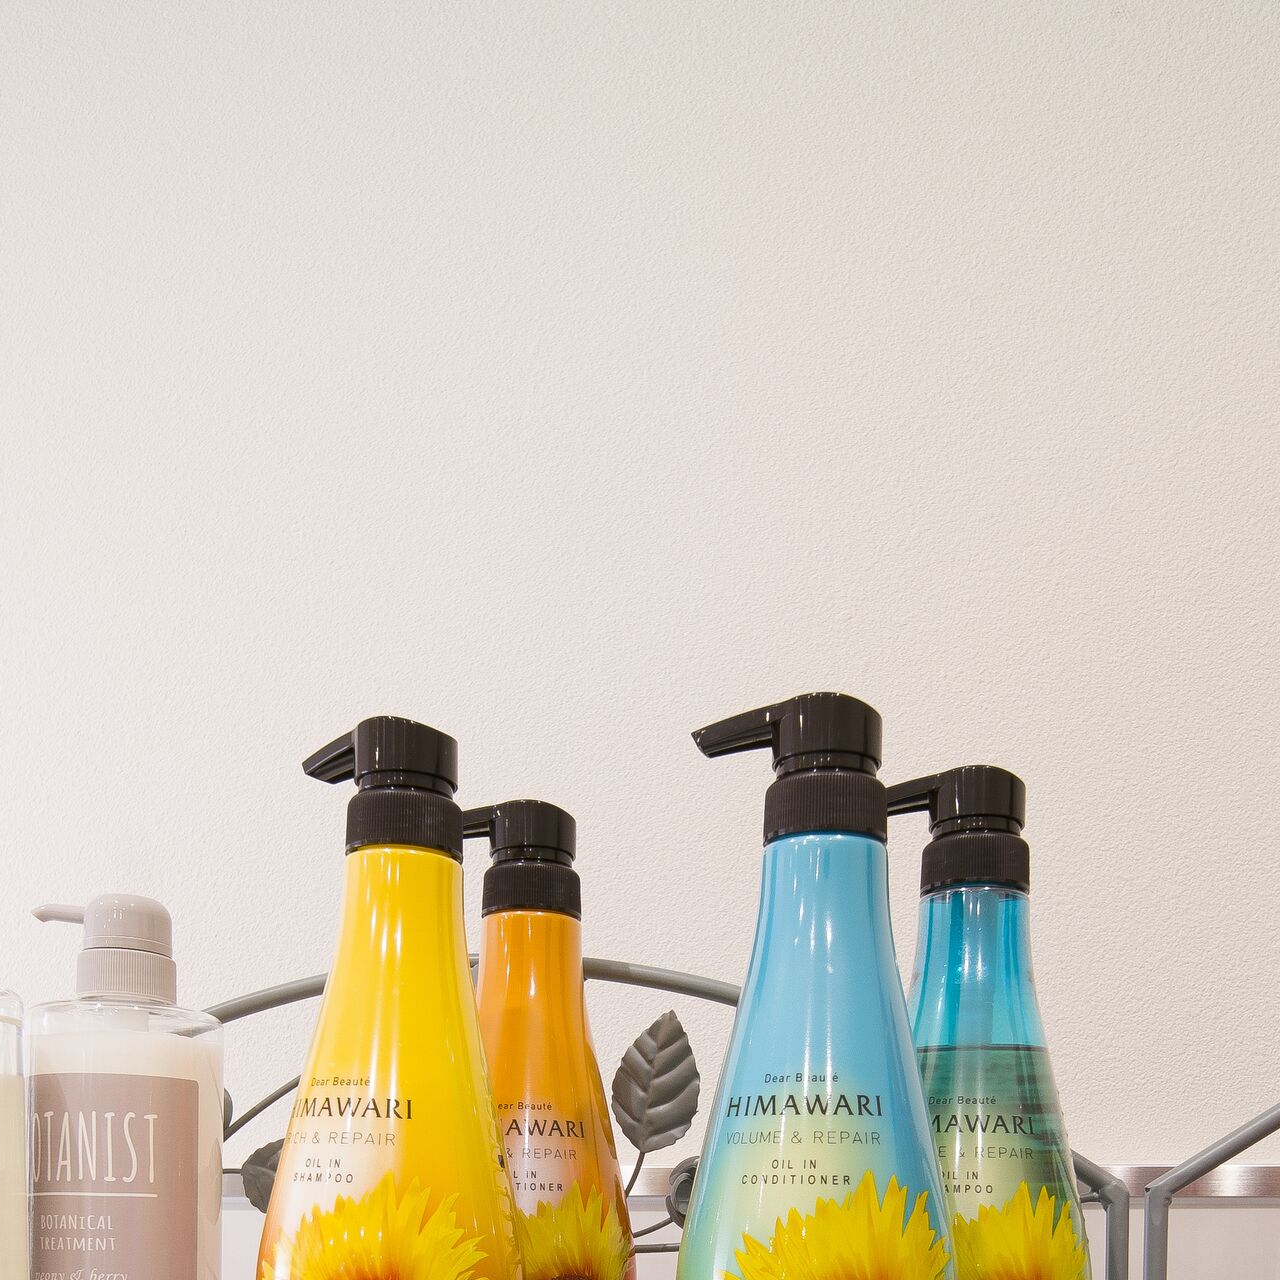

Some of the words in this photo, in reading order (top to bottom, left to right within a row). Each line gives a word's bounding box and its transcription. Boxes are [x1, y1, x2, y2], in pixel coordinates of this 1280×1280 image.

[311, 1077, 330, 1087] Dear
[332, 1075, 371, 1087] Beauté
[764, 1073, 791, 1084] Dear
[795, 1072, 839, 1083] Baué
[517, 1101, 552, 1111] Beauté
[727, 1094, 882, 1117] HIMAWARI
[928, 1096, 953, 1105] Dear
[957, 1095, 996, 1105] Beauté
[504, 1119, 585, 1138] AWARI
[311, 1131, 320, 1144] &
[328, 1131, 396, 1146] REPAIR
[726, 1130, 782, 1145] VOLUME
[790, 1130, 802, 1144] &
[813, 1130, 881, 1145] REPAIR
[522, 1147, 577, 1160] REPAIR
[974, 1146, 1034, 1159] REPAIR
[305, 1158, 321, 1168] OIL
[329, 1158, 341, 1168] IN
[771, 1159, 793, 1169] OIL
[803, 1159, 817, 1169] IN
[526, 1170, 537, 1179] IN
[741, 1174, 851, 1185] CONDITIONER
[966, 1171, 978, 1180] IN
[515, 1182, 563, 1192] TIONER
[40, 1214, 113, 1231] BOTANICAL
[39, 1236, 117, 1251] TREATMENT
